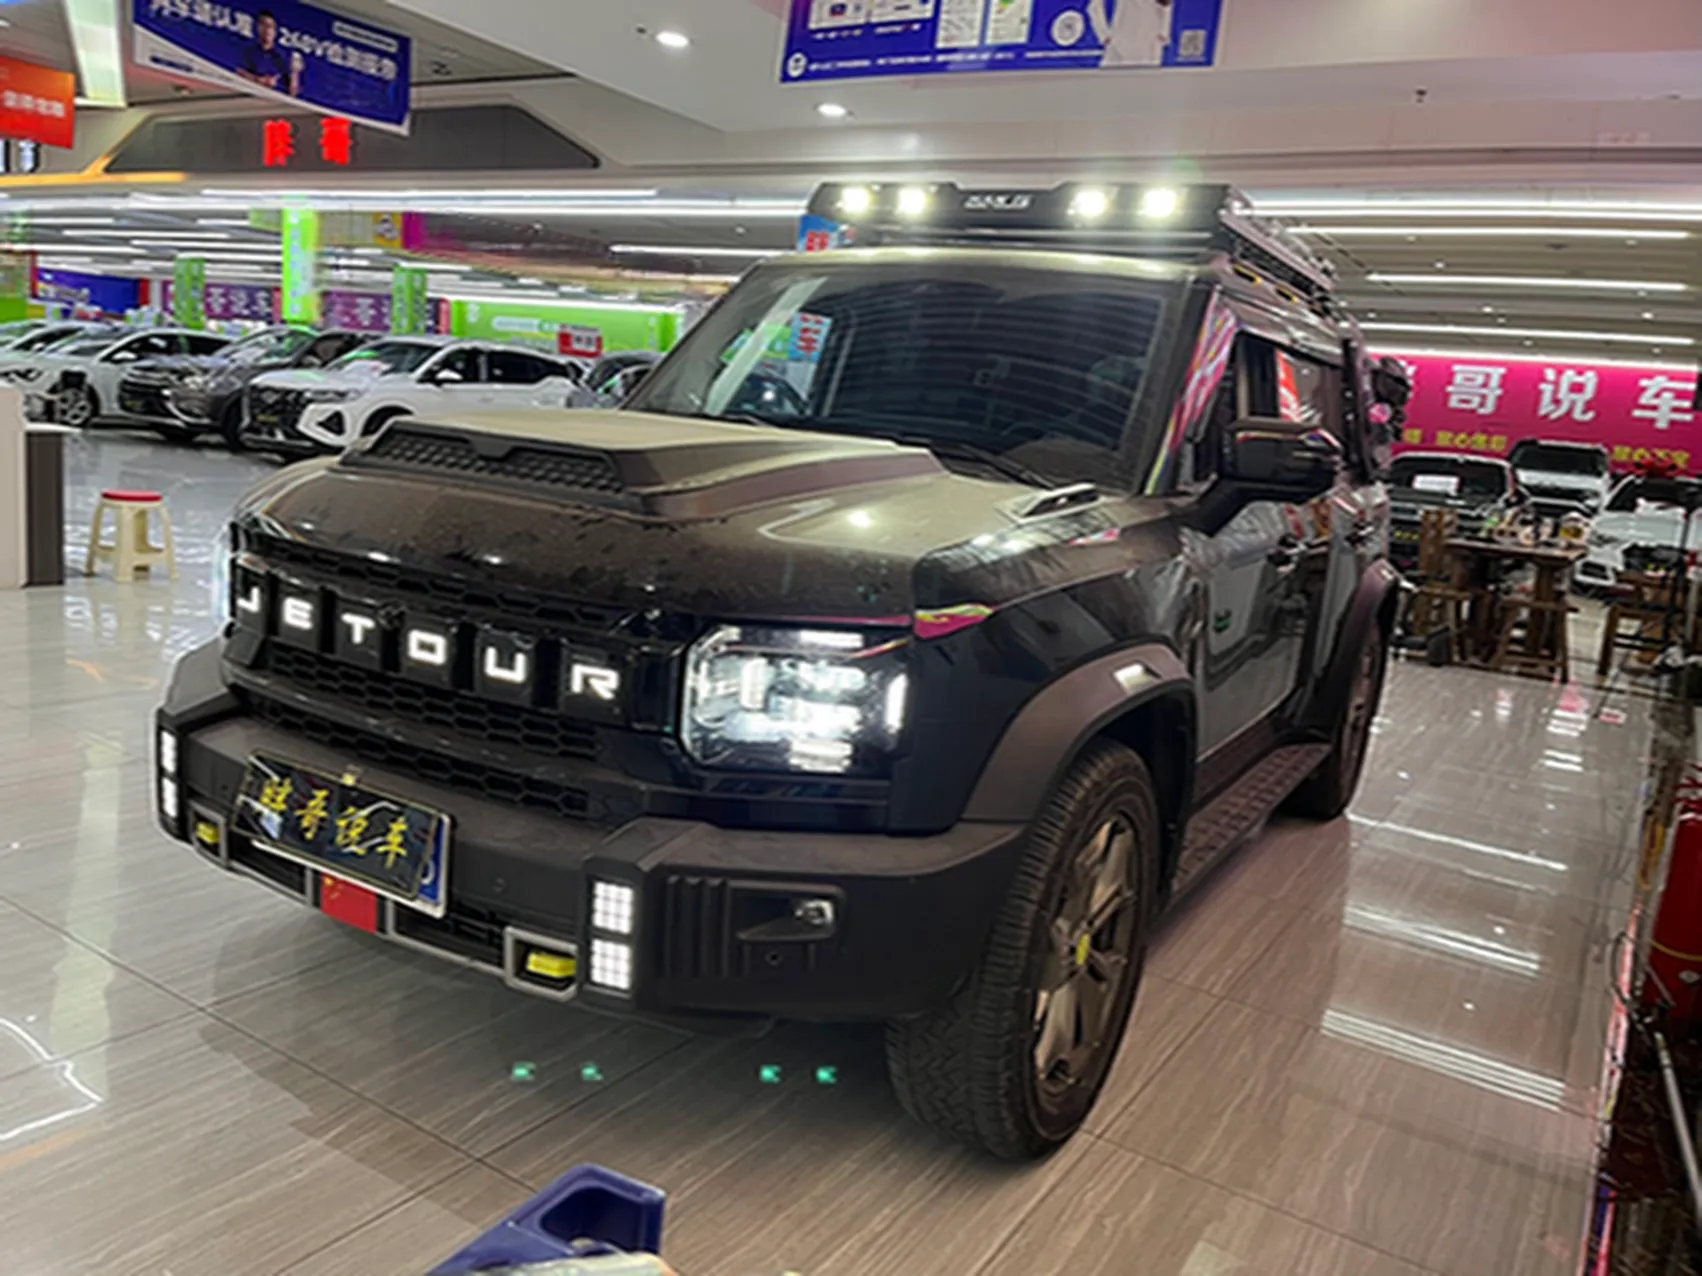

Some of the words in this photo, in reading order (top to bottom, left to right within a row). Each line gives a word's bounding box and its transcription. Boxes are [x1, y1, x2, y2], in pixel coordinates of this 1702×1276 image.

[1400, 360, 1698, 430] 哥说车
[236, 586, 620, 700] JETOUR
